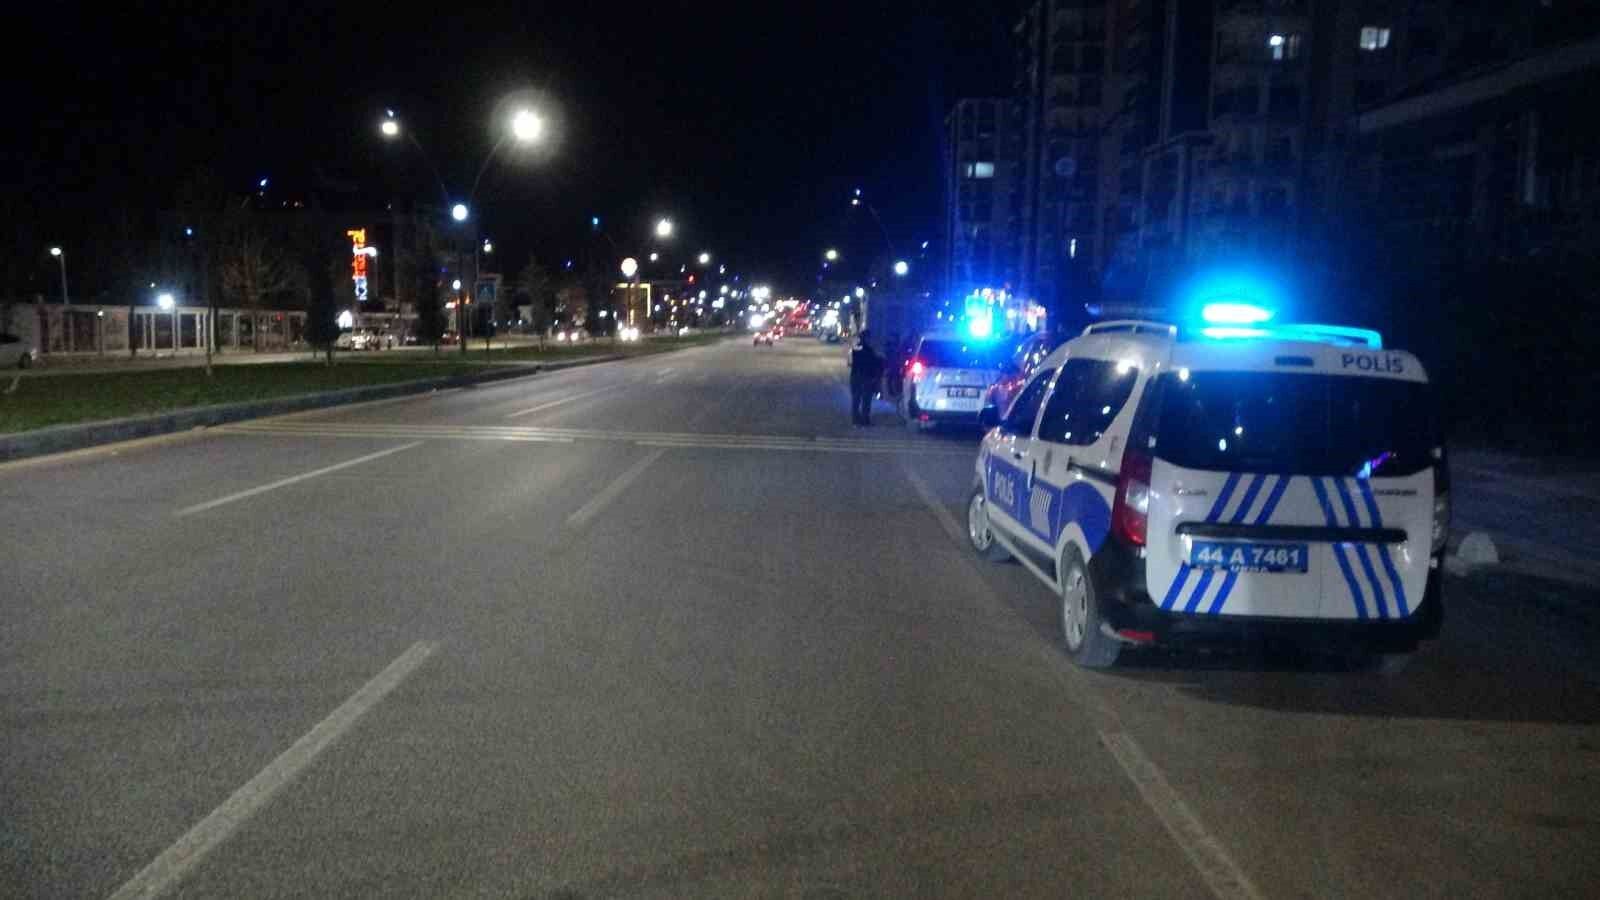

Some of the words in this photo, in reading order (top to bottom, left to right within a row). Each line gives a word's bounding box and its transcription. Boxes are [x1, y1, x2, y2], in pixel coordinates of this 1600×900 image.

[1342, 352, 1403, 373] POLİS
[1197, 546, 1223, 563] 44
[1229, 547, 1245, 564] A
